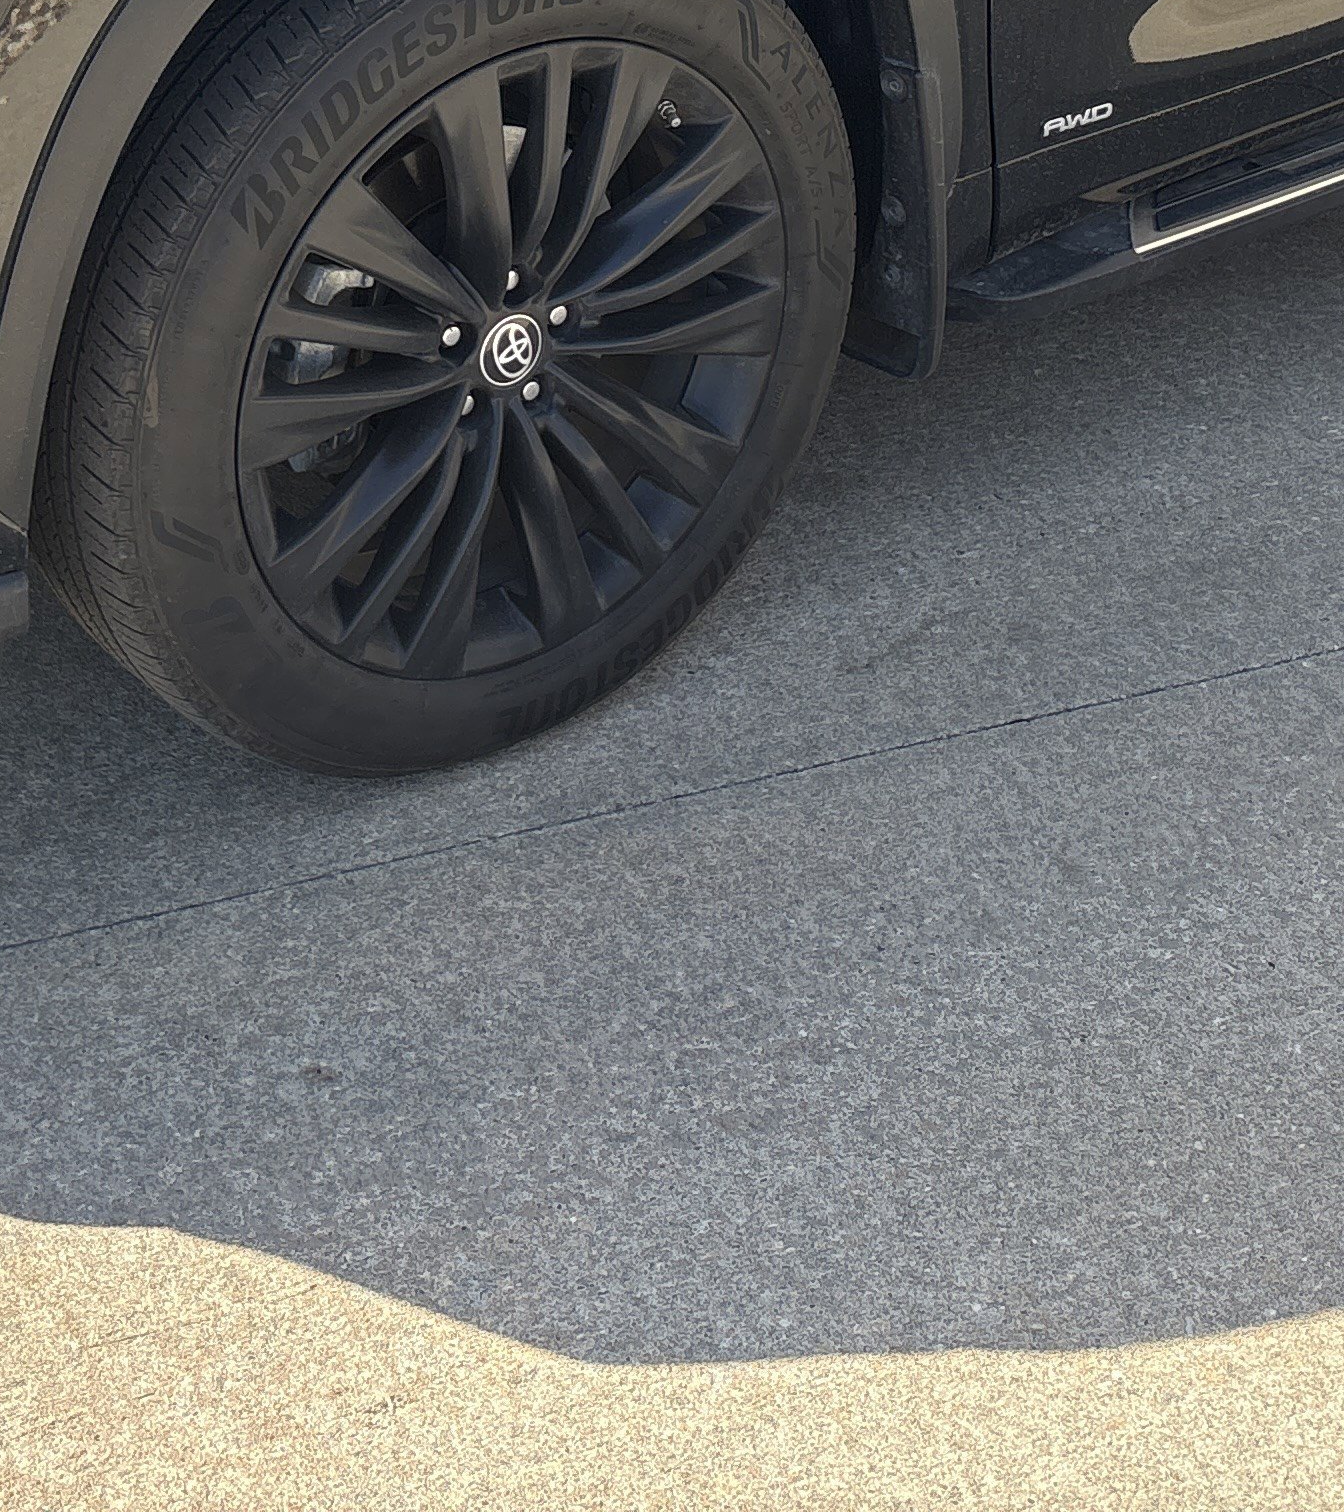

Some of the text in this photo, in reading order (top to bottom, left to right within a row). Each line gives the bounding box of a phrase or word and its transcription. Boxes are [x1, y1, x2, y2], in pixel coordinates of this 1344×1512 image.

[770, 40, 850, 239] ALENZA
[779, 100, 824, 197] SPORT A/S
[1043, 103, 1114, 138] AWD
